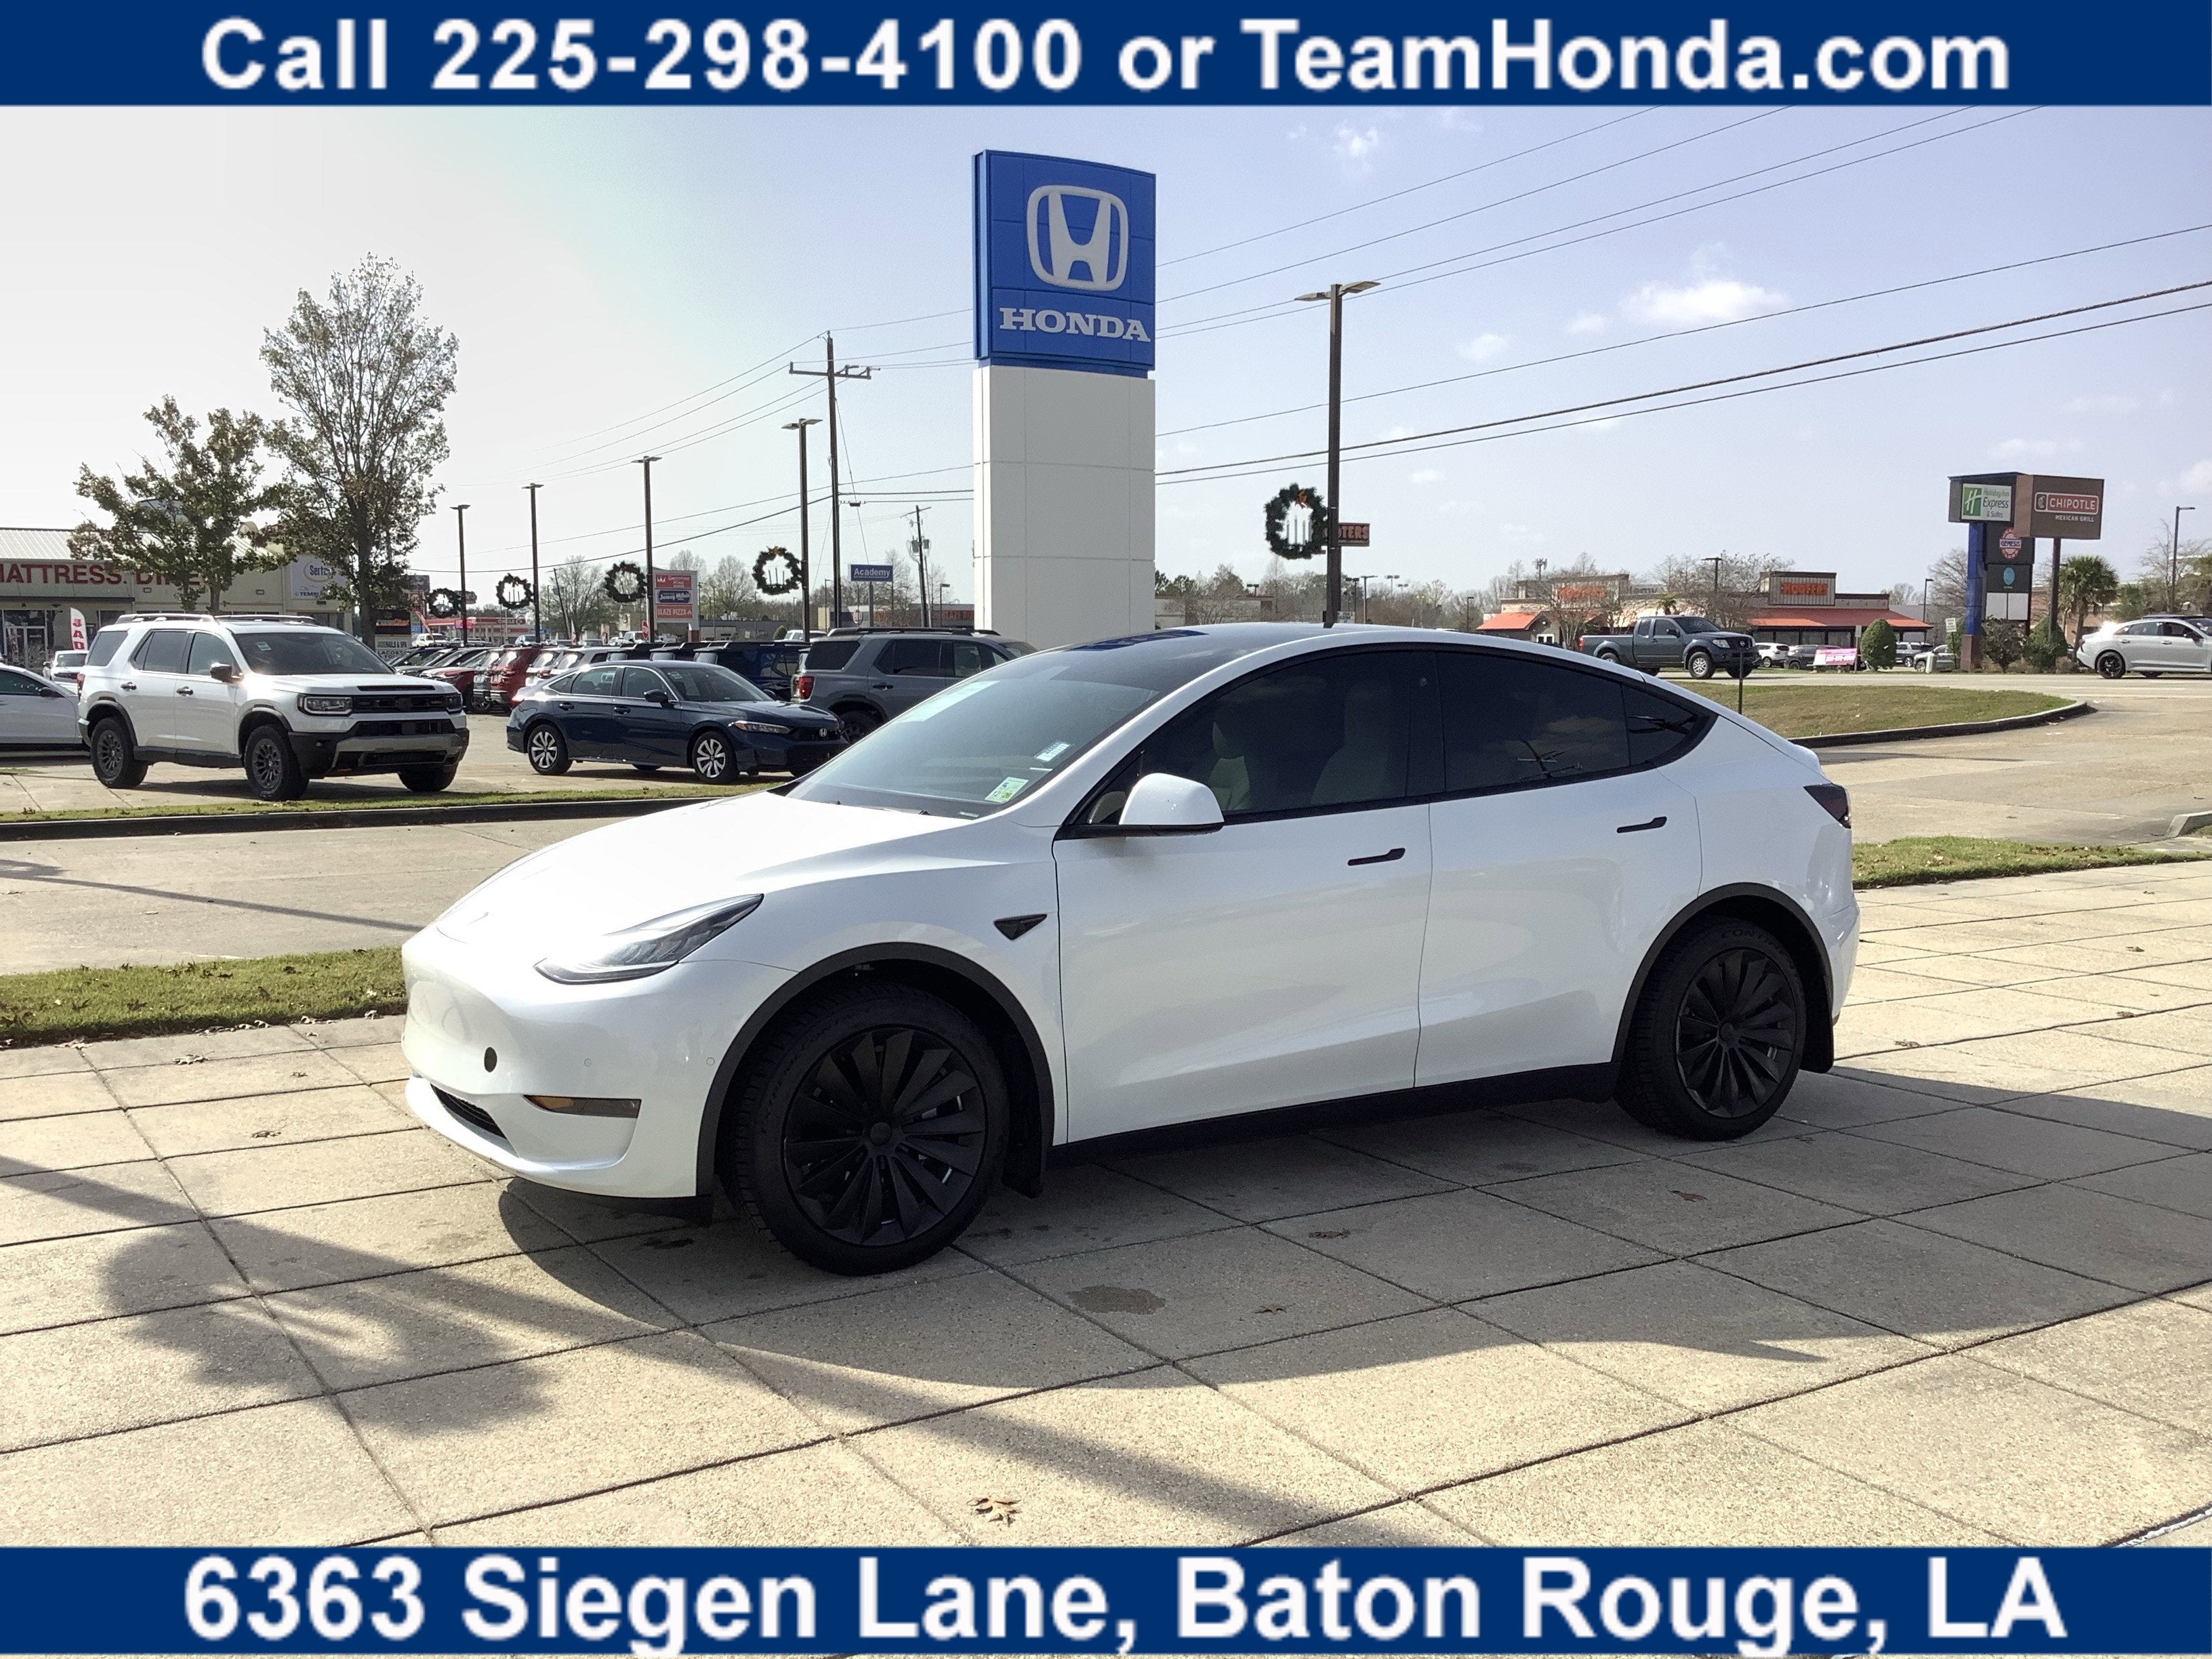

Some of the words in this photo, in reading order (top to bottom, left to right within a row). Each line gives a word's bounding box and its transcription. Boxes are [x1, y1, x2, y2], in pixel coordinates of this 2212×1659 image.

[999, 307, 1151, 343] HONDA
[1983, 487, 2002, 498] Holiday
[1983, 496, 2009, 510] Express
[2049, 497, 2096, 510] CHIPOTLE
[1990, 510, 2004, 518] Suites
[0, 564, 122, 586] ATTRESS
[854, 567, 890, 578] Academy
